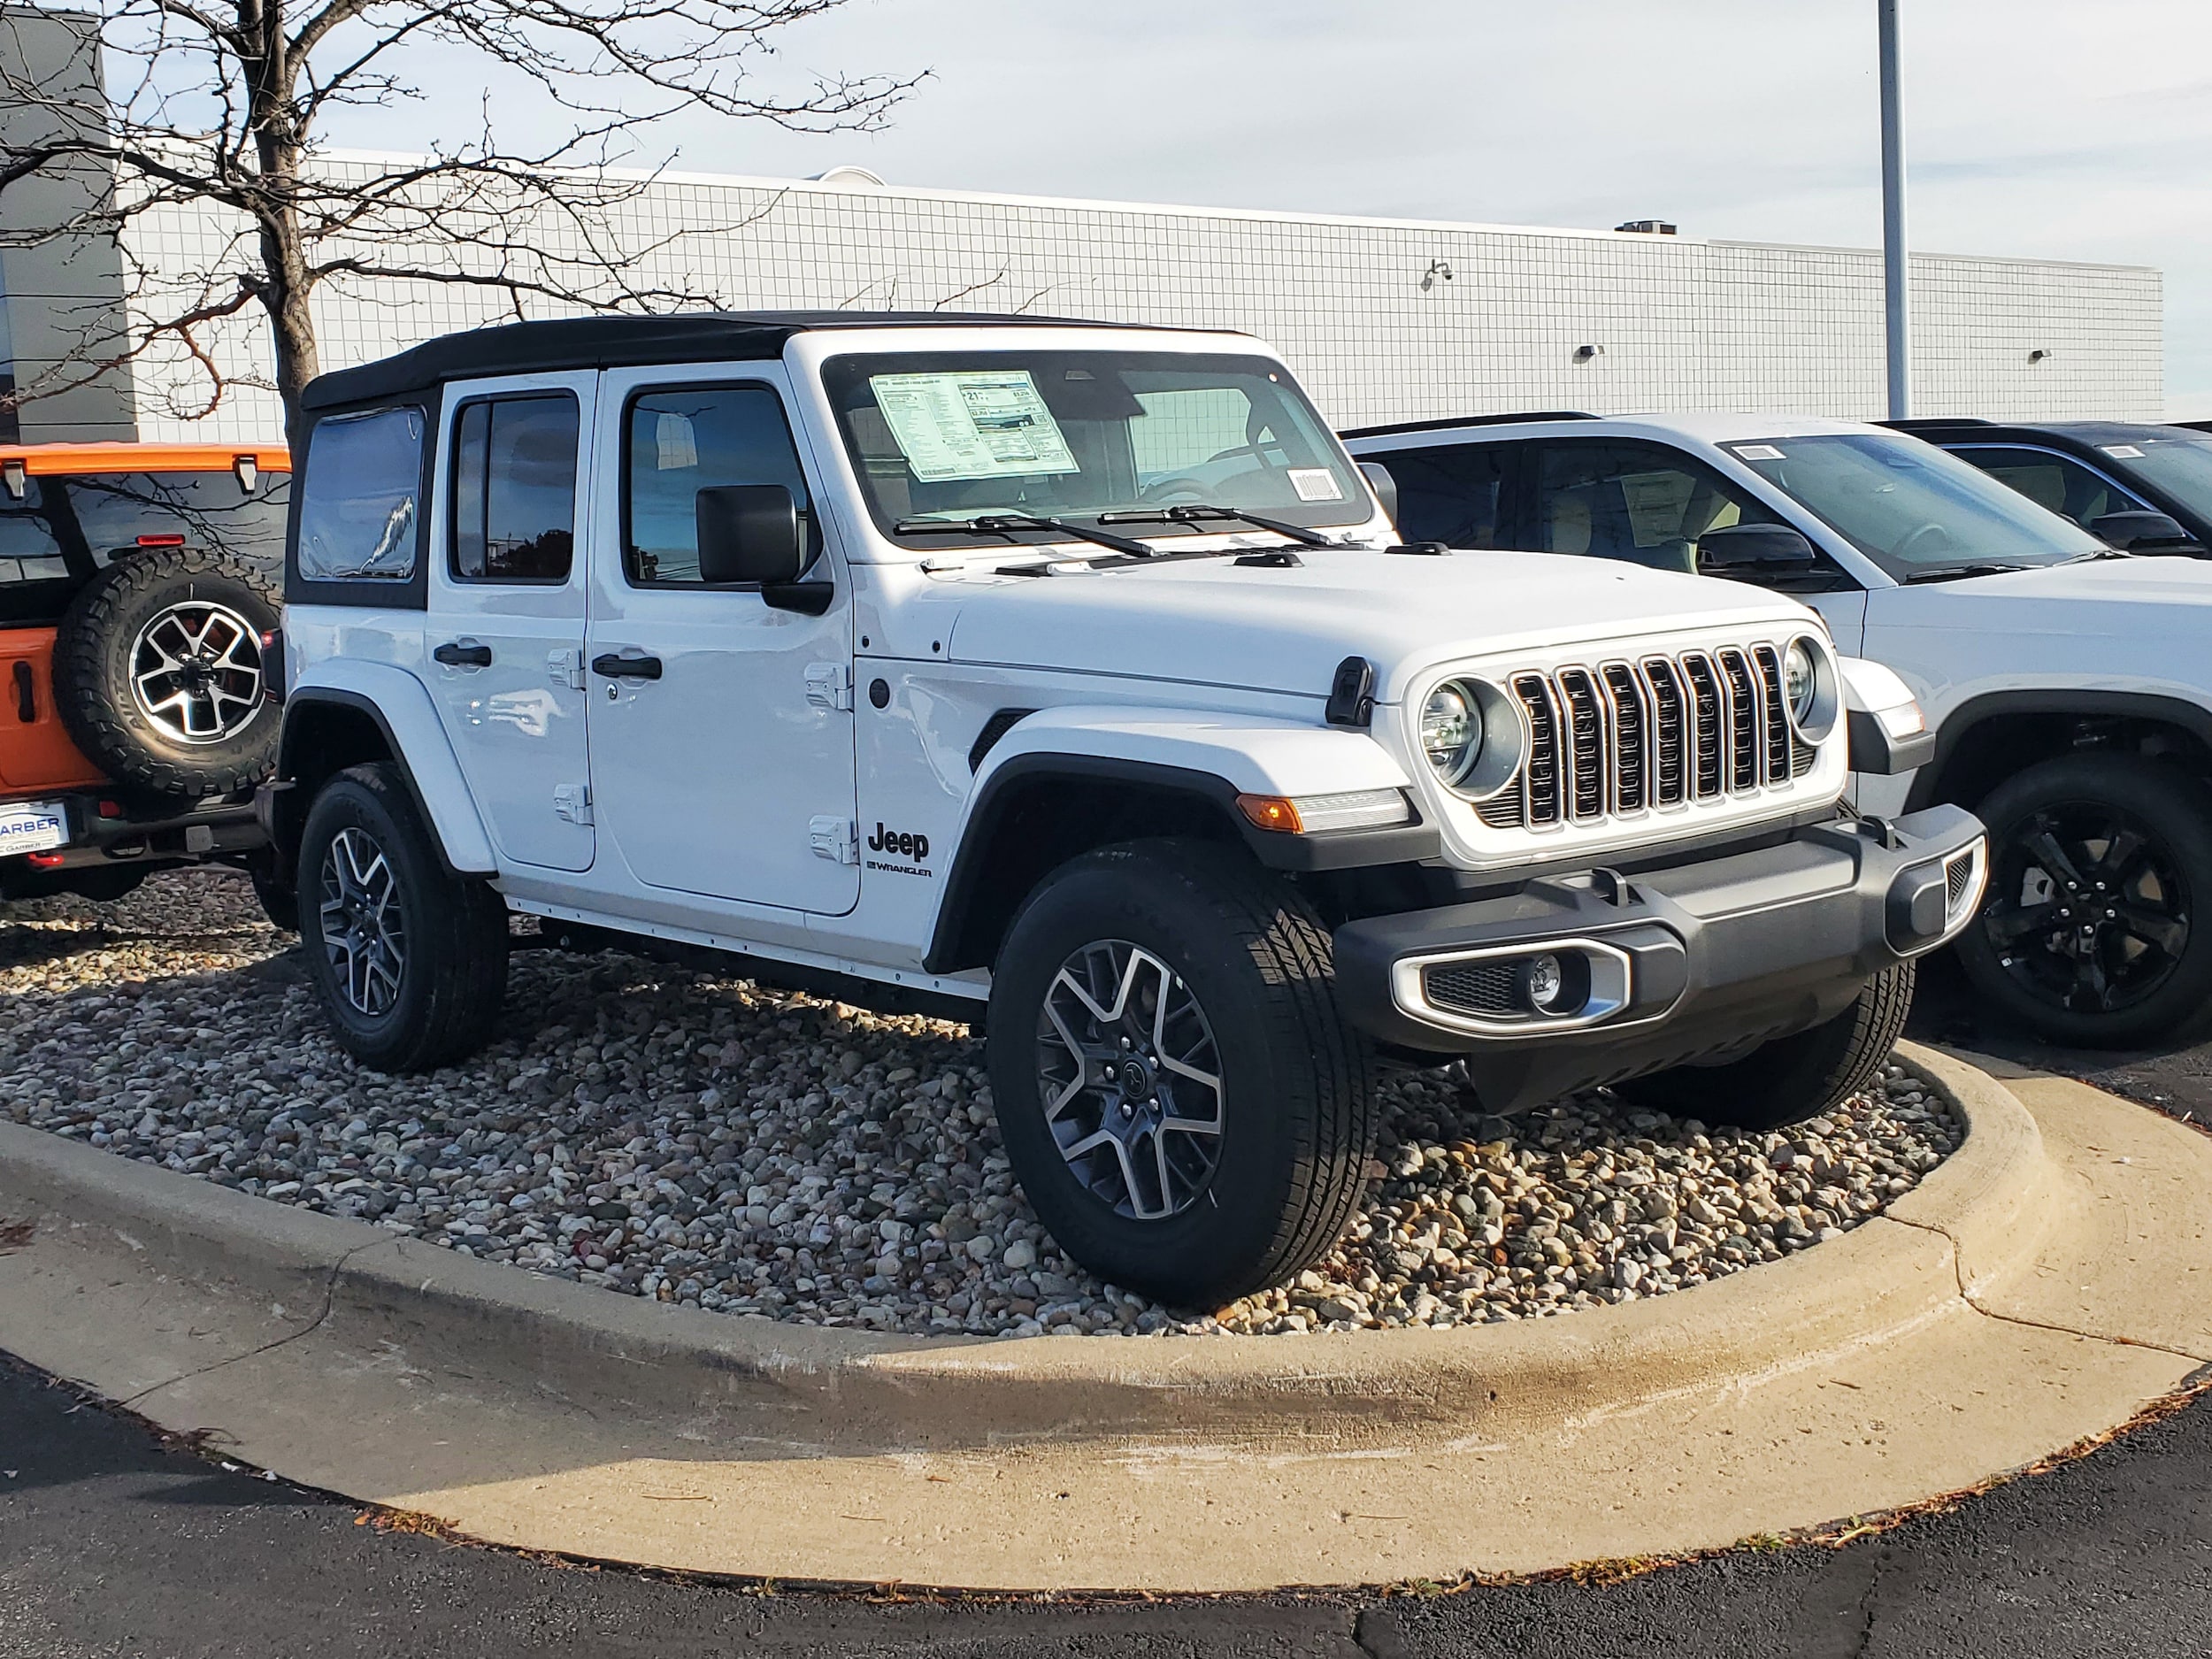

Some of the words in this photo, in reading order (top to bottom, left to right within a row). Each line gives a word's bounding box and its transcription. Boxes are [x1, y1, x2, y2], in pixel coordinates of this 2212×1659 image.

[0, 818, 60, 836] ARBER
[868, 822, 928, 863] Jeep
[877, 862, 932, 877] WRANGLER
